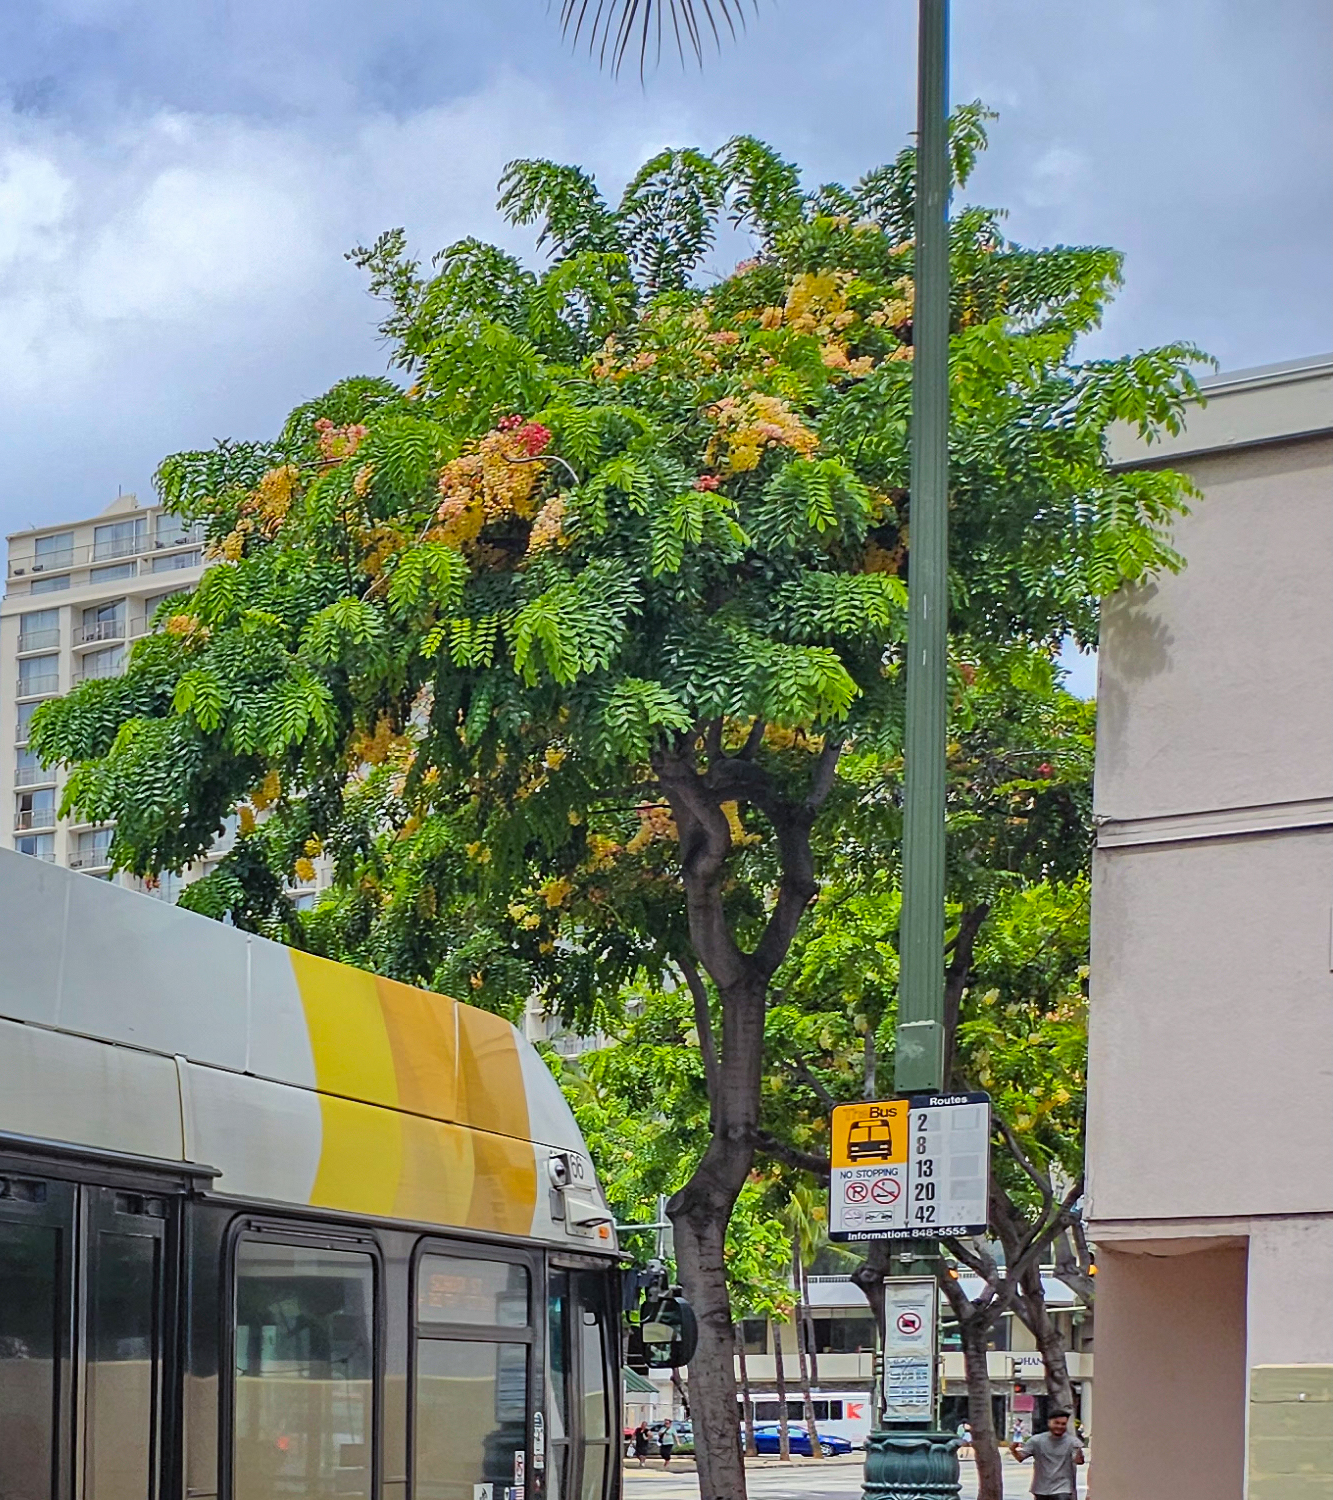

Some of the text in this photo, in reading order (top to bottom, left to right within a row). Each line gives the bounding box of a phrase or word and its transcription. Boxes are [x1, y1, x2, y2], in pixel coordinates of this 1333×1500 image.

[929, 1096, 968, 1106] Routes
[917, 1113, 928, 1132] 2
[916, 1136, 927, 1154] 8
[840, 1167, 899, 1179] NO STOPPING
[915, 1159, 933, 1178] 13
[914, 1182, 935, 1201] 20
[914, 1205, 935, 1223] 42
[847, 1227, 967, 1241] Information: 848-5555
